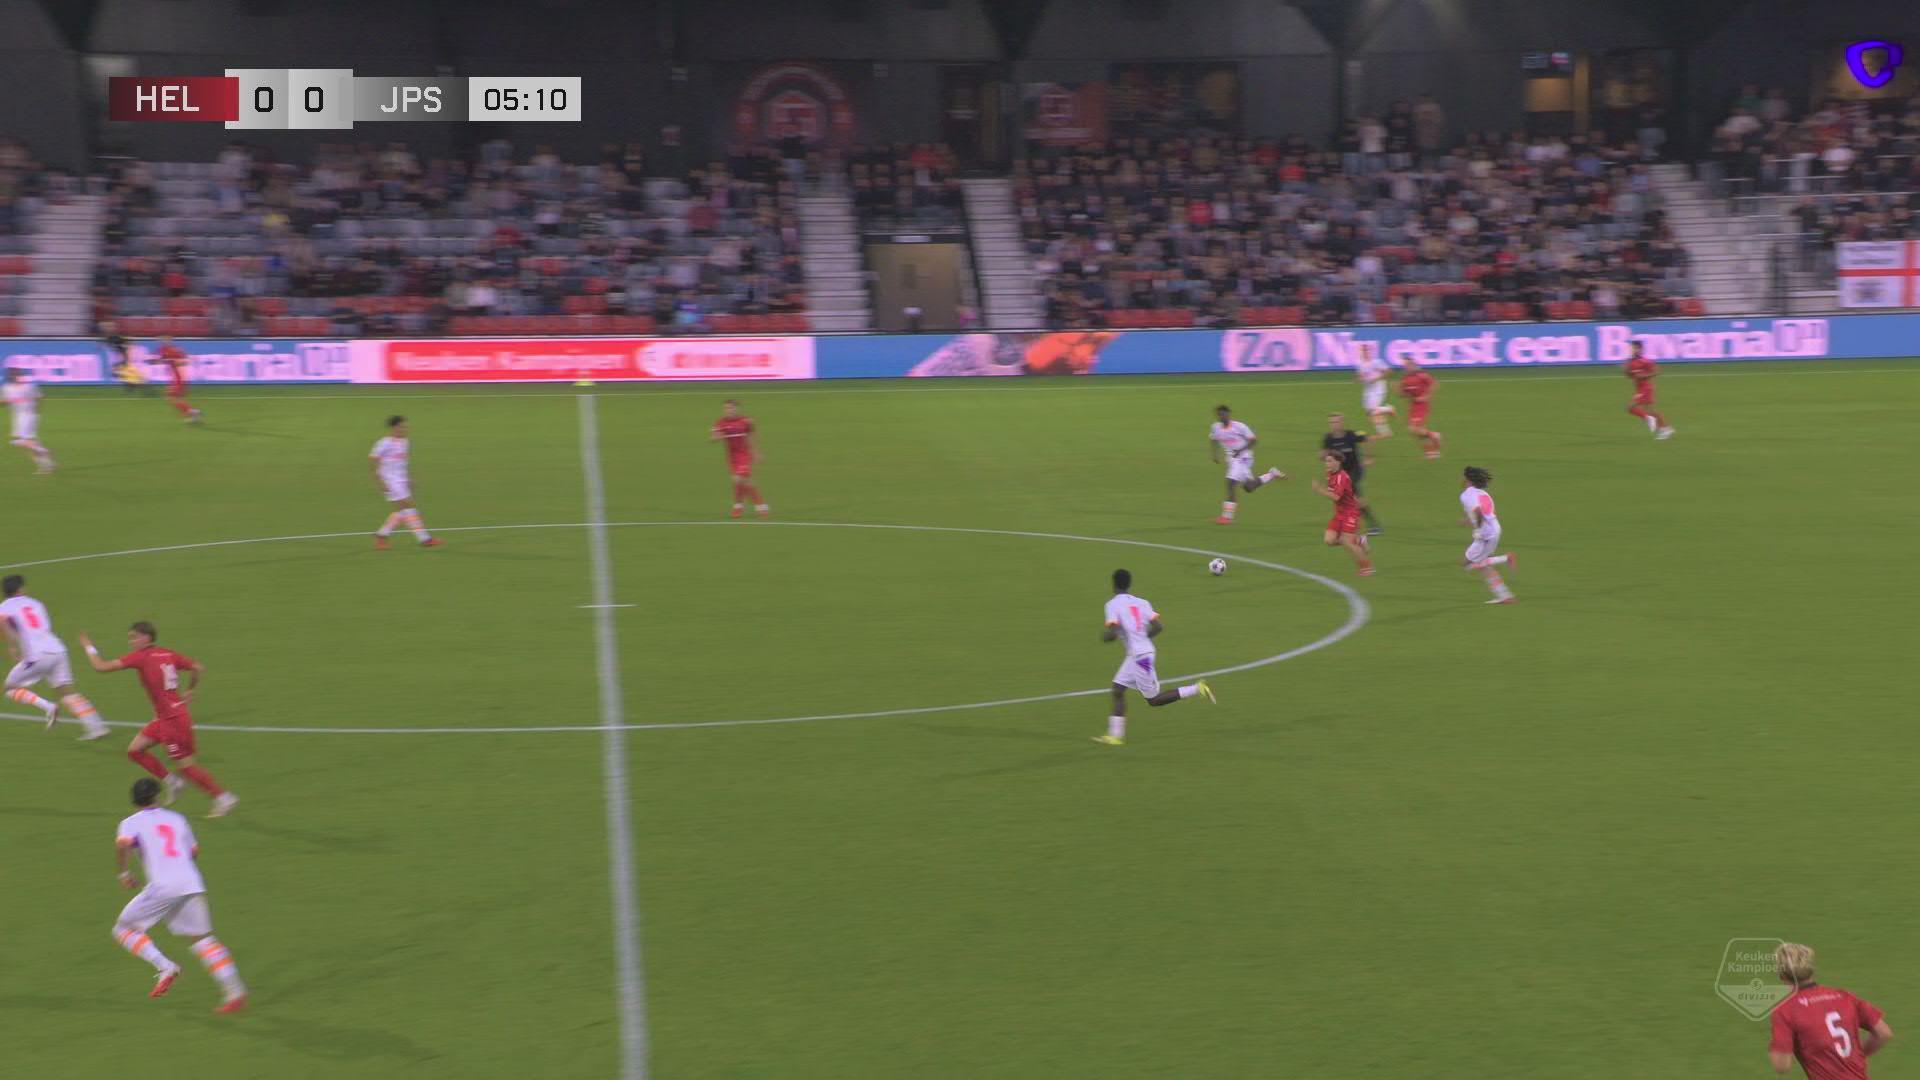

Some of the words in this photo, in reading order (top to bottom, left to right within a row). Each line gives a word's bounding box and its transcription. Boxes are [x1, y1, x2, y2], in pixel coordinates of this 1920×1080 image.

[102, 343, 300, 381] Baria
[1386, 332, 1502, 366] eerst
[1507, 335, 1590, 363] een
[155, 824, 181, 857] 2
[1825, 1011, 1851, 1058] 5
